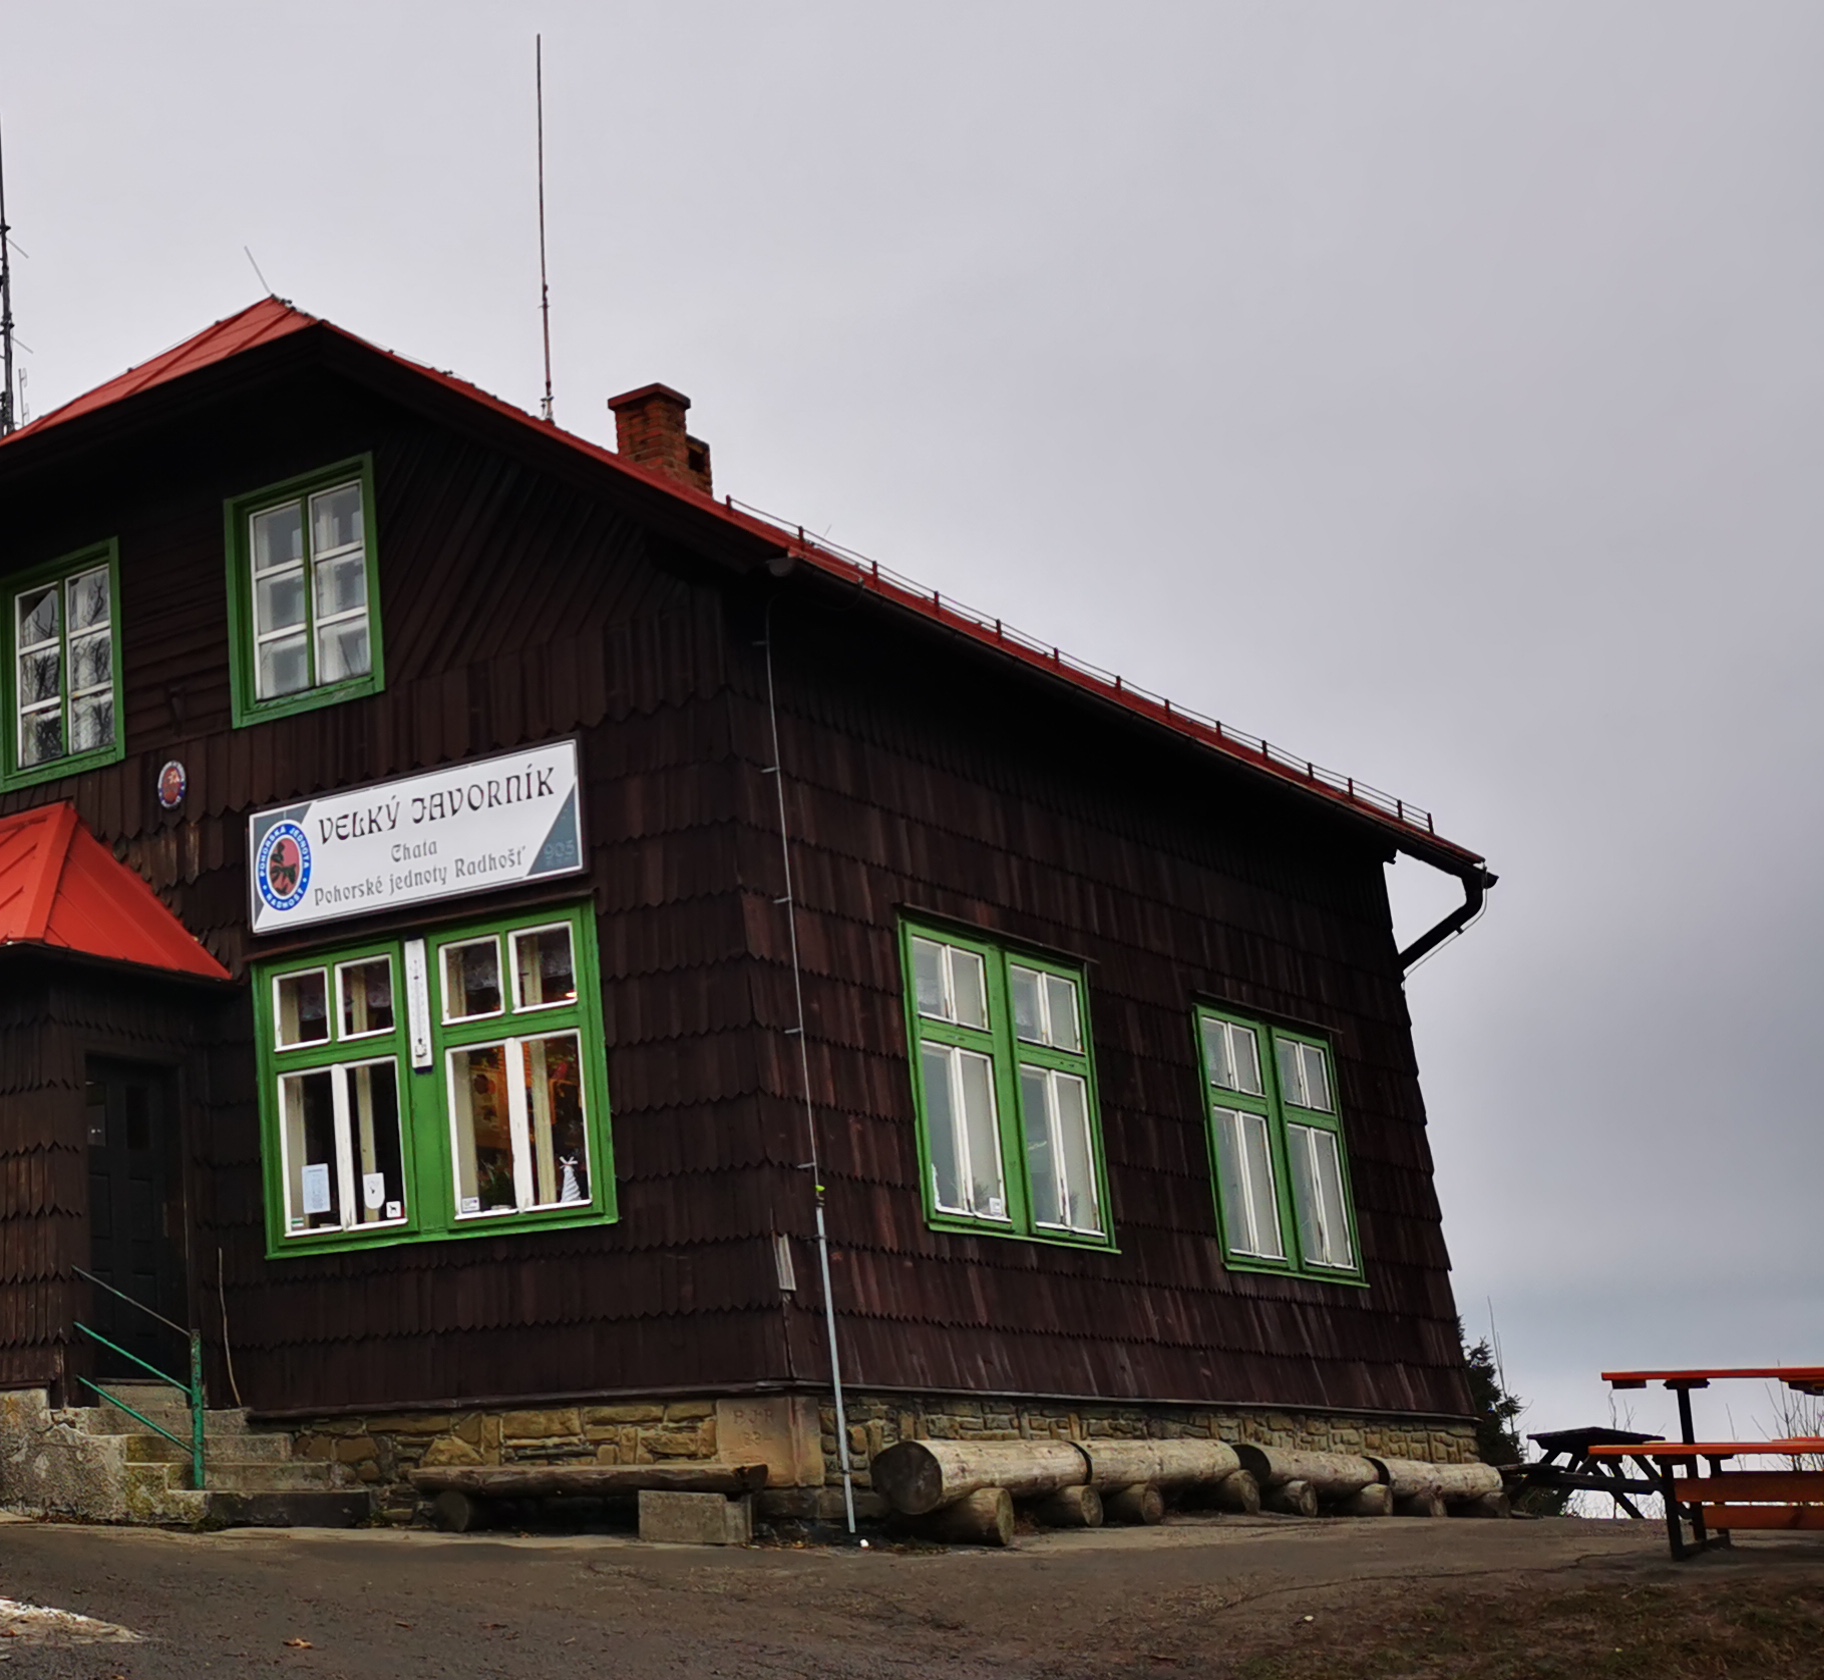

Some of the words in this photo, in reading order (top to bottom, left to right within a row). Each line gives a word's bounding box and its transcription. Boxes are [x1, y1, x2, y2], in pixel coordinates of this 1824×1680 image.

[411, 763, 555, 824] JAVORNÍK
[314, 875, 384, 907] Pohorské
[389, 865, 448, 896] jednoty
[453, 845, 527, 879] Radhošť
[390, 839, 438, 863] Chata
